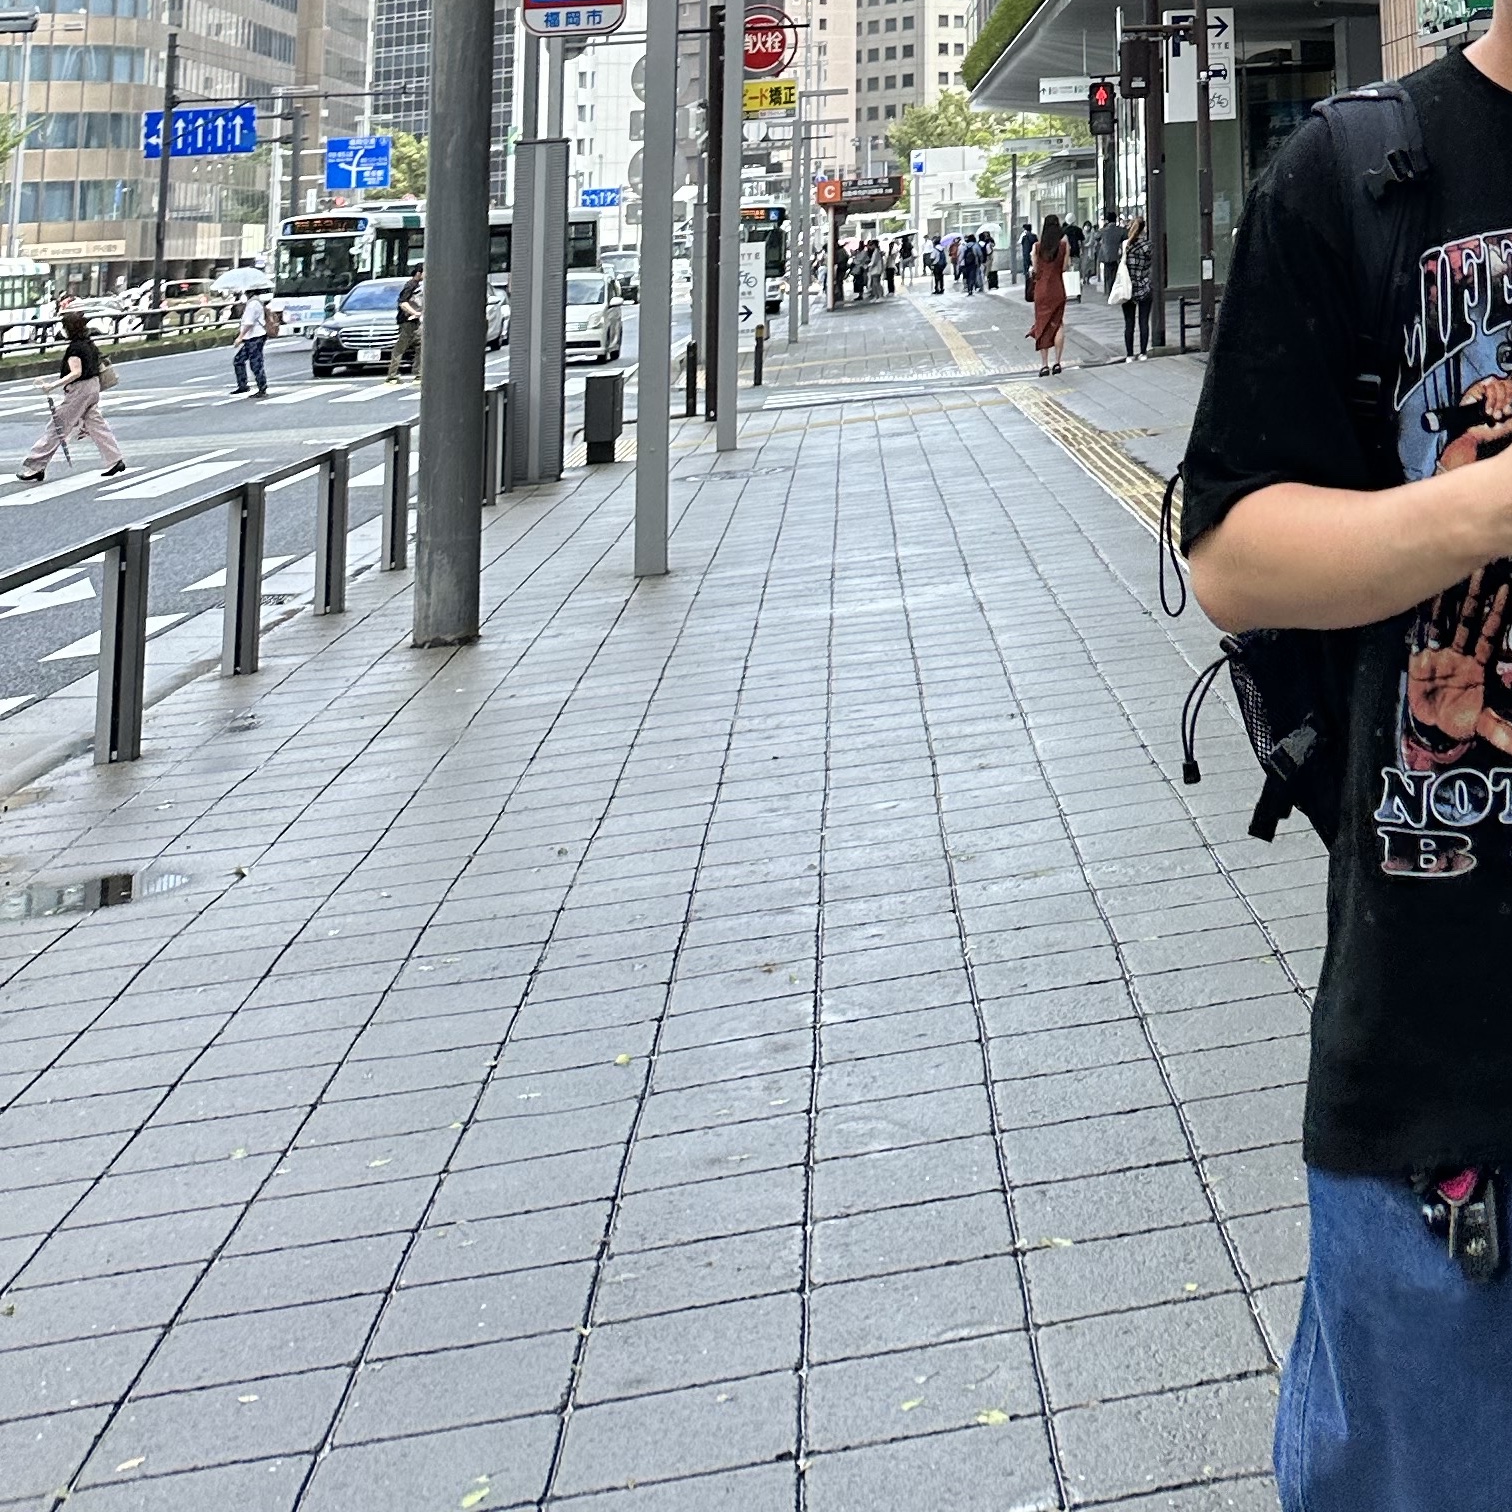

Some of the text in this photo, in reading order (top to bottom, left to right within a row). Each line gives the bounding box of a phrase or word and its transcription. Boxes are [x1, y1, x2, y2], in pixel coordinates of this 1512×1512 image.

[543, 9, 603, 28] 福岡市
[824, 185, 836, 199] C
